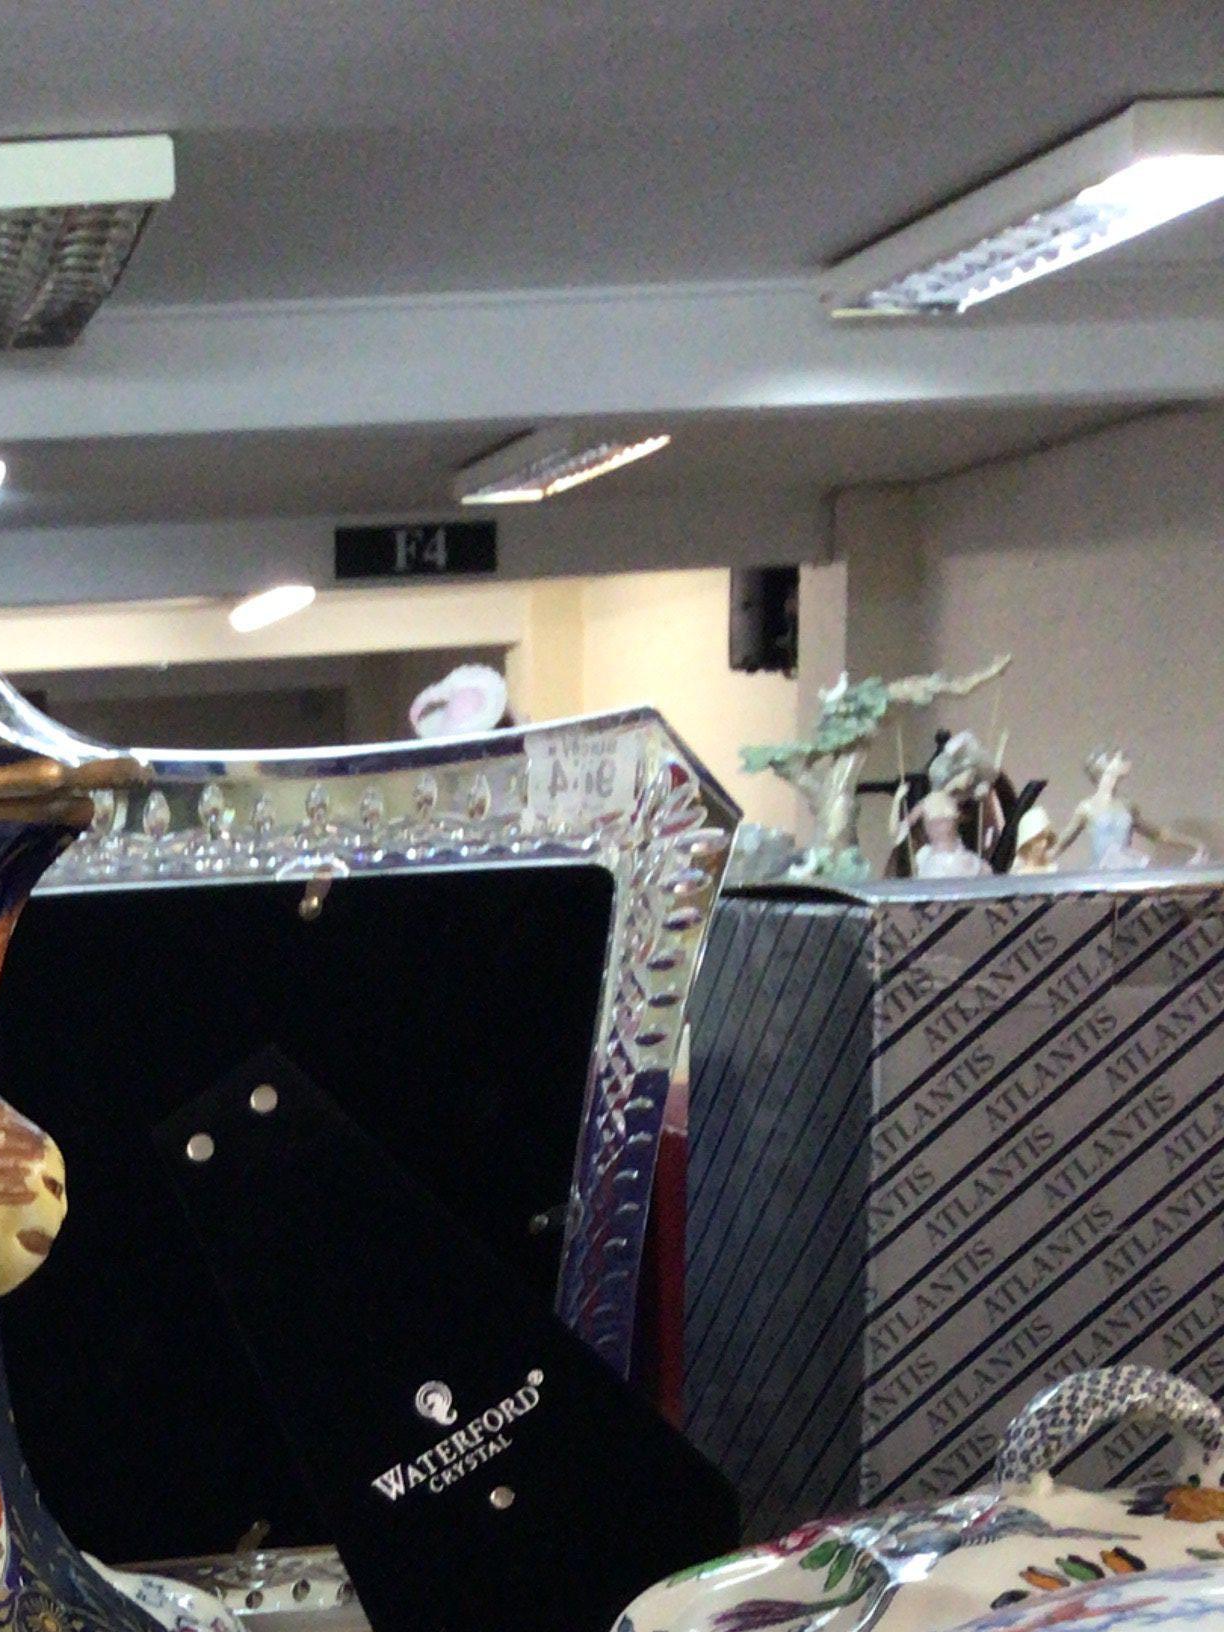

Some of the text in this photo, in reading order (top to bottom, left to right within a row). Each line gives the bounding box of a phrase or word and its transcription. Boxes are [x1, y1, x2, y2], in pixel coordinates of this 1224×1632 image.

[924, 928, 1058, 1052] ATLANTIS
[985, 1005, 1118, 1132] ATLANTIS
[926, 1123, 1055, 1247] ATLANTIS
[1045, 1086, 1175, 1207] ATLANTIS
[984, 1202, 1114, 1325] ATLANTIS
[927, 1314, 1054, 1437] ATLANTIS
[371, 1385, 540, 1501] WATERFORD
[429, 1433, 513, 1494] CRYSTAL
